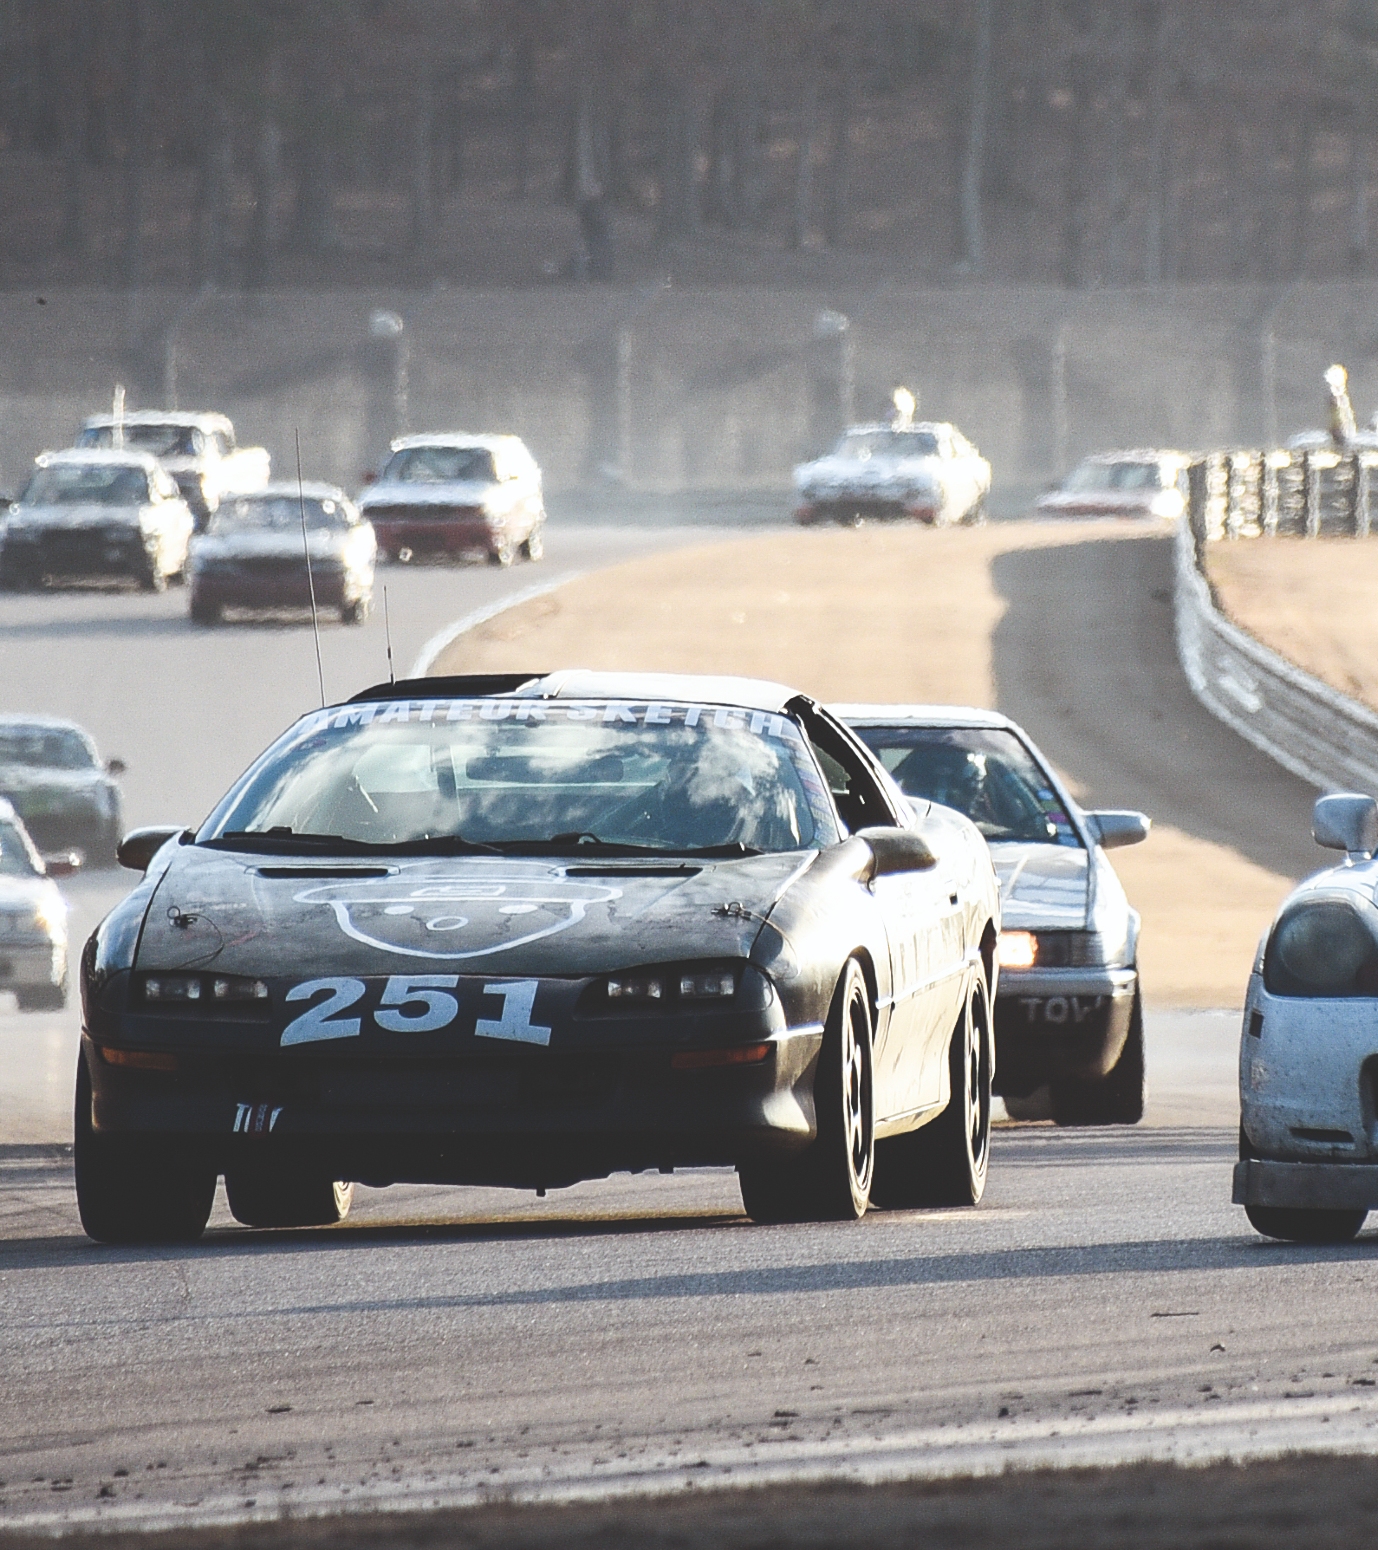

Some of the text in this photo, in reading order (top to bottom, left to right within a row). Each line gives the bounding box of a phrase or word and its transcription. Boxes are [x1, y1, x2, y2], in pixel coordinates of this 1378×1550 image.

[302, 700, 784, 738] AMATEUR SKETCH
[279, 974, 552, 1047] 251
